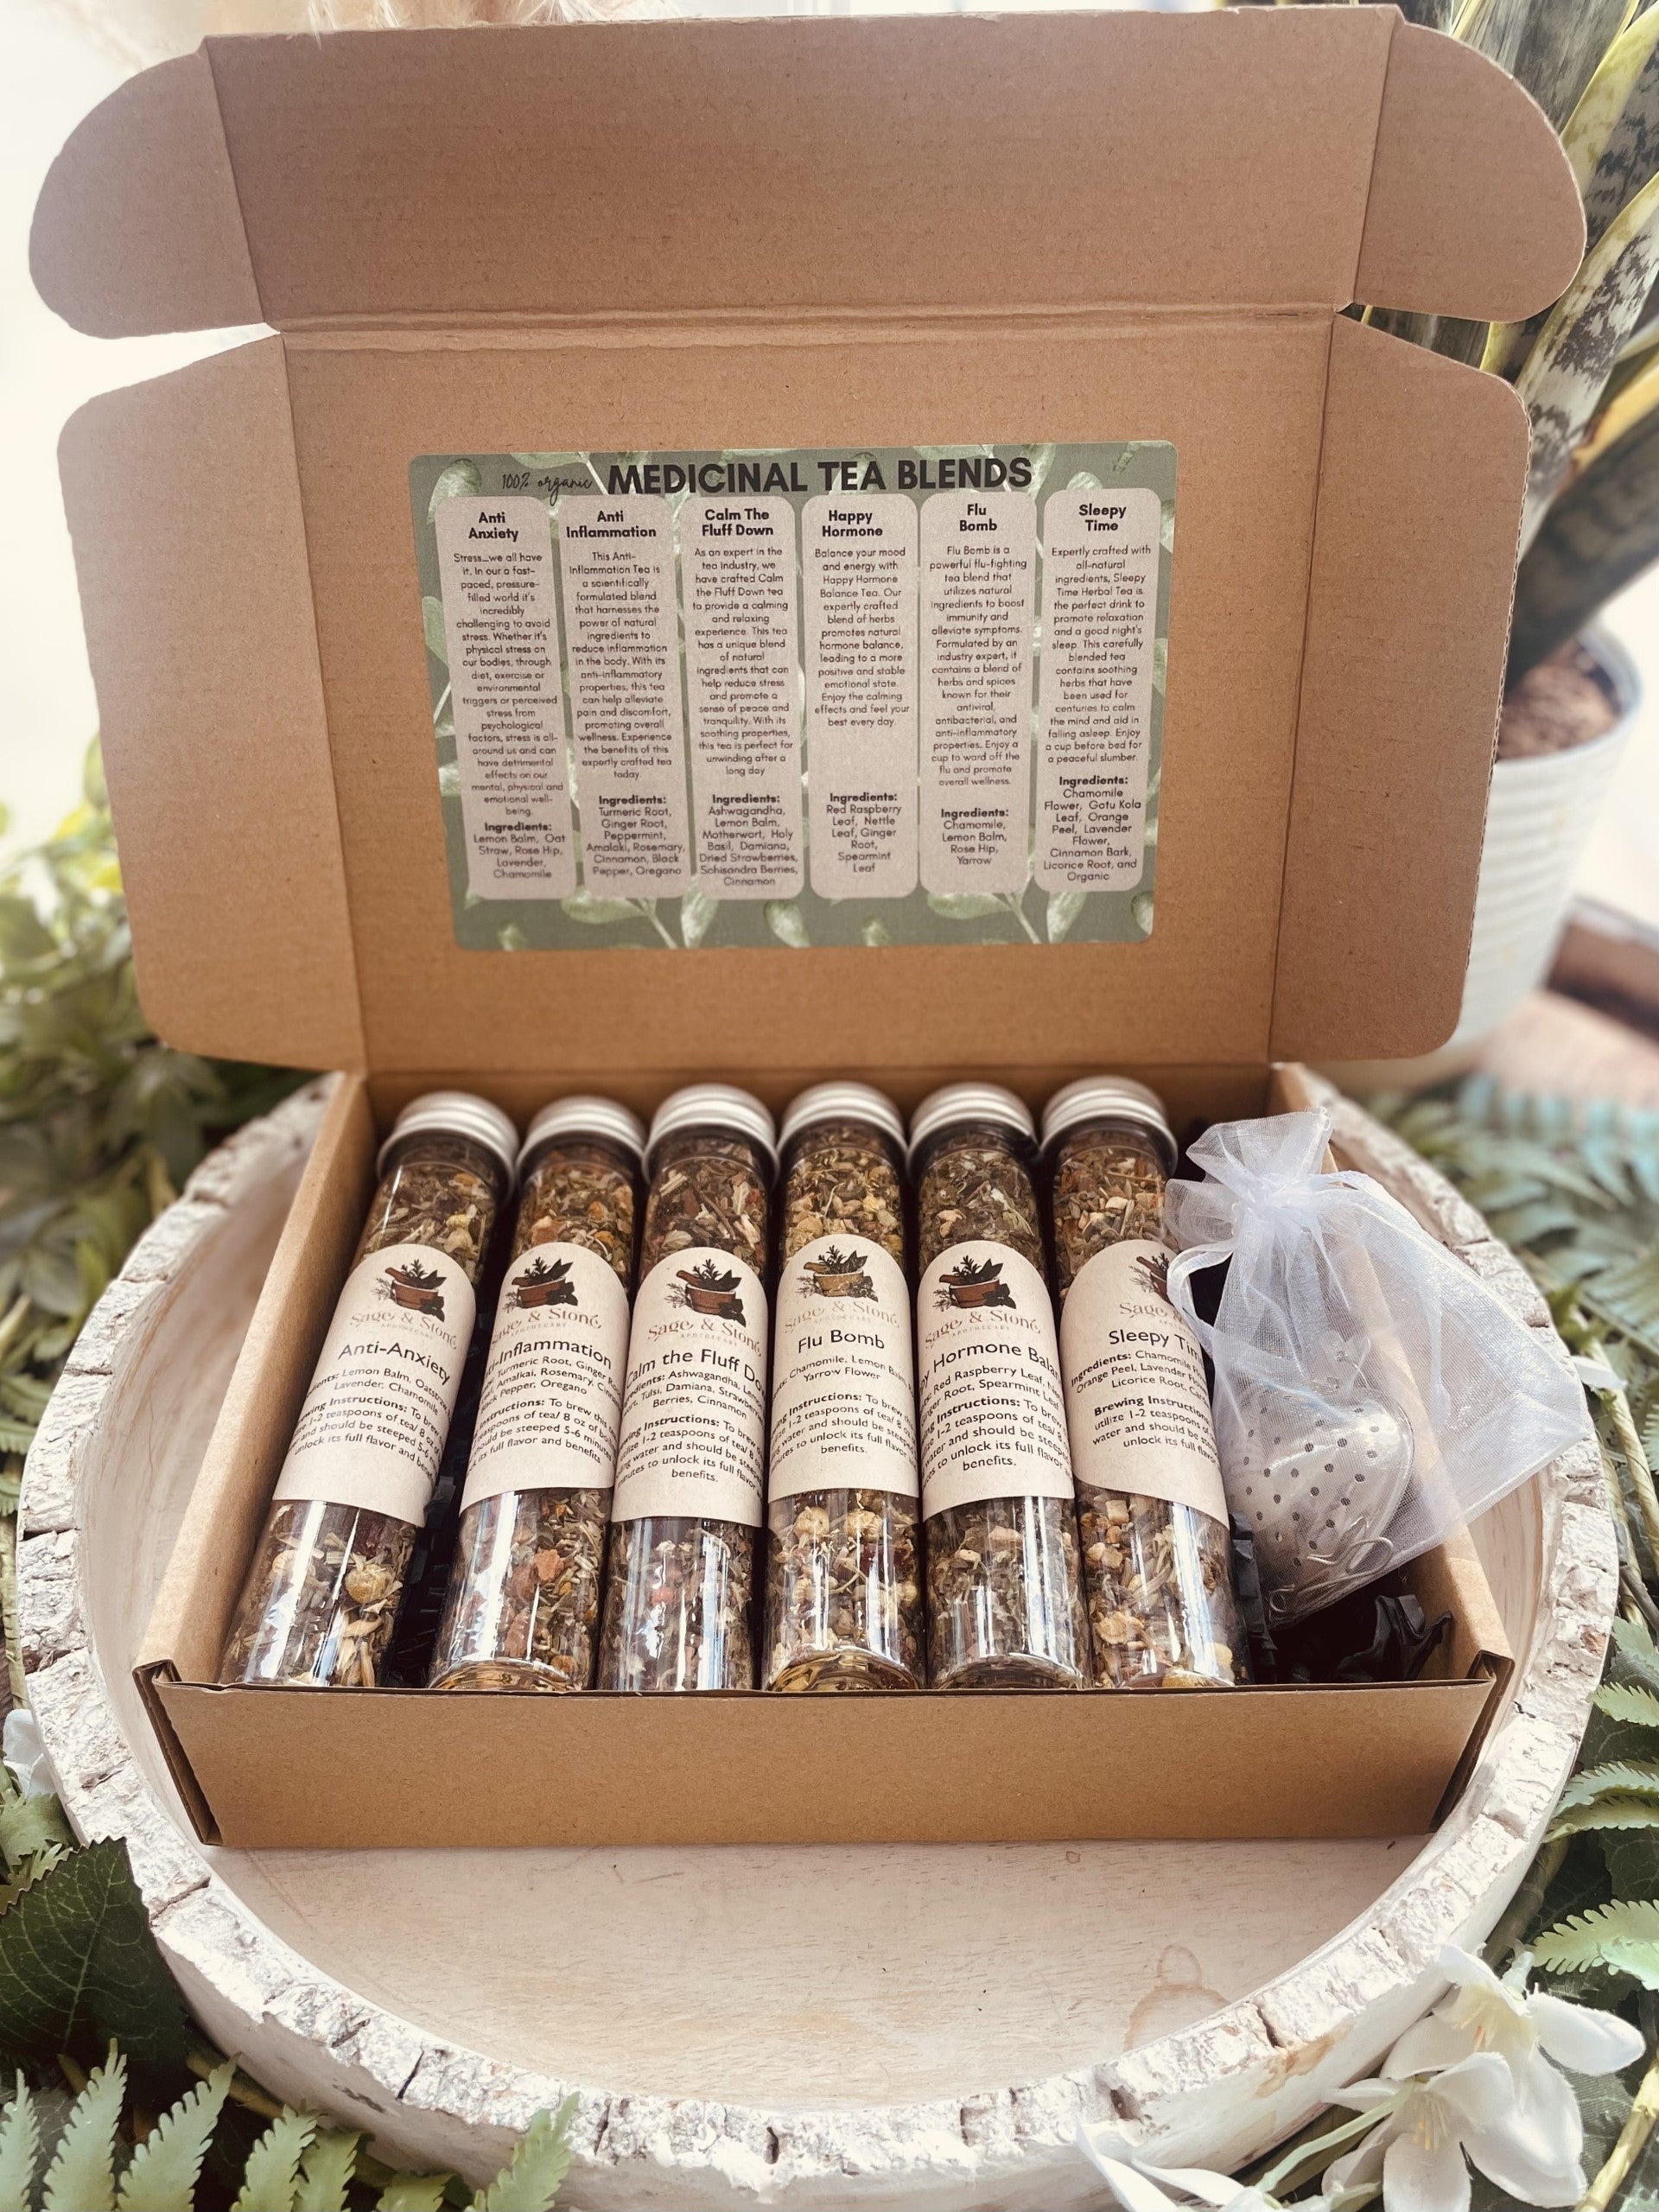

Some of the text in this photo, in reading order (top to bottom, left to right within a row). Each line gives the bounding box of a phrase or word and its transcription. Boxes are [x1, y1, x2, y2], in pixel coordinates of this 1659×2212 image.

[608, 457, 1033, 493] MEDICINAL TEA BLENDS
[502, 472, 593, 505] 100% organic
[597, 510, 624, 522] Anti
[705, 507, 769, 521] Calm The
[967, 503, 987, 516] Flu
[1078, 503, 1127, 519] Sleepy
[479, 512, 505, 524] Anti
[829, 509, 873, 525] Happy
[566, 525, 657, 538] Inflammation
[702, 523, 774, 537] Fluff Down
[822, 525, 883, 537] Hormone
[959, 518, 997, 532] Bomb
[1084, 519, 1118, 531] Time
[468, 527, 518, 543] Anxiety
[815, 547, 906, 560] Balance your mood
[1052, 544, 1151, 559] Expertly crafted with
[930, 558, 1027, 572] powerful flu-fighting
[696, 572, 783, 583] have crafted Calm
[456, 619, 510, 631] challenging
[525, 618, 550, 627] avoid
[580, 617, 657, 630] power of natural
[1059, 774, 1128, 788] Ingredients:
[712, 792, 780, 806] Ingredients:
[830, 791, 898, 804] Ingredients:
[1063, 788, 1123, 798] Chamomile
[599, 794, 666, 807] Ingredients:
[1045, 798, 1141, 811] Flower, Gotu Kola
[599, 807, 671, 817] Turmeric Root,
[708, 805, 785, 817] Ashwagandha,
[826, 804, 902, 817] Red Raspberry
[941, 807, 1009, 820] Ingredients:
[601, 818, 667, 830] Ginger Root,
[715, 817, 779, 827] Lemon Balm,
[833, 815, 895, 827] Leaf, Nettle
[1056, 811, 1128, 824] Leaf, Orange
[484, 822, 552, 834] Ingredients:
[943, 820, 1006, 830] Chamomile,
[1052, 822, 1132, 835] Peel, Lavender
[474, 833, 565, 843] Lemon Balm, Oat
[604, 830, 666, 842] Peppermint,
[702, 828, 793, 841] Motherwort, Holy
[832, 827, 896, 840] Leaf, Ginger
[942, 831, 1007, 842] Lemon Balm,
[708, 841, 789, 851] Basil, Damiana,
[851, 840, 877, 850] Root,
[1073, 836, 1109, 846] Flower,
[479, 845, 563, 857] Straw, Rose Hip,
[633, 842, 685, 854] Rosemary,
[950, 844, 998, 855] Rose Hip,
[1050, 846, 1131, 858] Cinnamon Bark,
[497, 857, 546, 868] Lavender,
[594, 853, 678, 863] Cinnamon, Black
[700, 852, 798, 862] Dried Strawberries,
[838, 851, 891, 863] Spearmint
[957, 856, 992, 865] Yarrow
[701, 865, 798, 874] Schisandra Berries,
[853, 862, 875, 873] Leaf
[1044, 859, 1137, 870] Licorice Root, and
[493, 869, 552, 879] Chamomile
[593, 866, 682, 878] Pepper, Oregano
[1067, 871, 1109, 883] Organic
[723, 876, 775, 886] Cinnamon
[969, 1311, 982, 1323] &
[702, 1318, 715, 1331] &
[798, 1330, 885, 1353] Flu Bomb
[1109, 1329, 1169, 1347] Sleepy
[339, 1341, 450, 1385] Anti-Anxiety
[663, 1350, 693, 1364] the
[702, 1349, 740, 1372] Fluff
[852, 1355, 886, 1370] Lemon
[933, 1343, 1022, 1373] Hormone
[343, 1368, 379, 1377] Lemon
[498, 1358, 538, 1377] Turmeric
[576, 1361, 606, 1379] Ginger
[804, 1366, 880, 1382] Yarrow Flower
[1071, 1351, 1192, 1387] Ingredients: Chamomile
[933, 1376, 950, 1391] Red
[955, 1365, 1016, 1380] Raspberry
[1077, 1371, 1109, 1393] Orange
[1141, 1363, 1185, 1378] Lavender
[1112, 1376, 1155, 1388] Licorice
[541, 1379, 587, 1395] Oregano
[979, 1379, 1040, 1396] Spearmint
[389, 1382, 438, 1416] Chamomile
[697, 1395, 747, 1419] Cinnamon
[938, 1396, 1020, 1422] Instructions:
[1095, 1397, 1144, 1416] Brewing
[1095, 1414, 1124, 1430] utilize
[963, 1456, 1016, 1471] benefits.
[672, 1470, 718, 1483] benefits.
